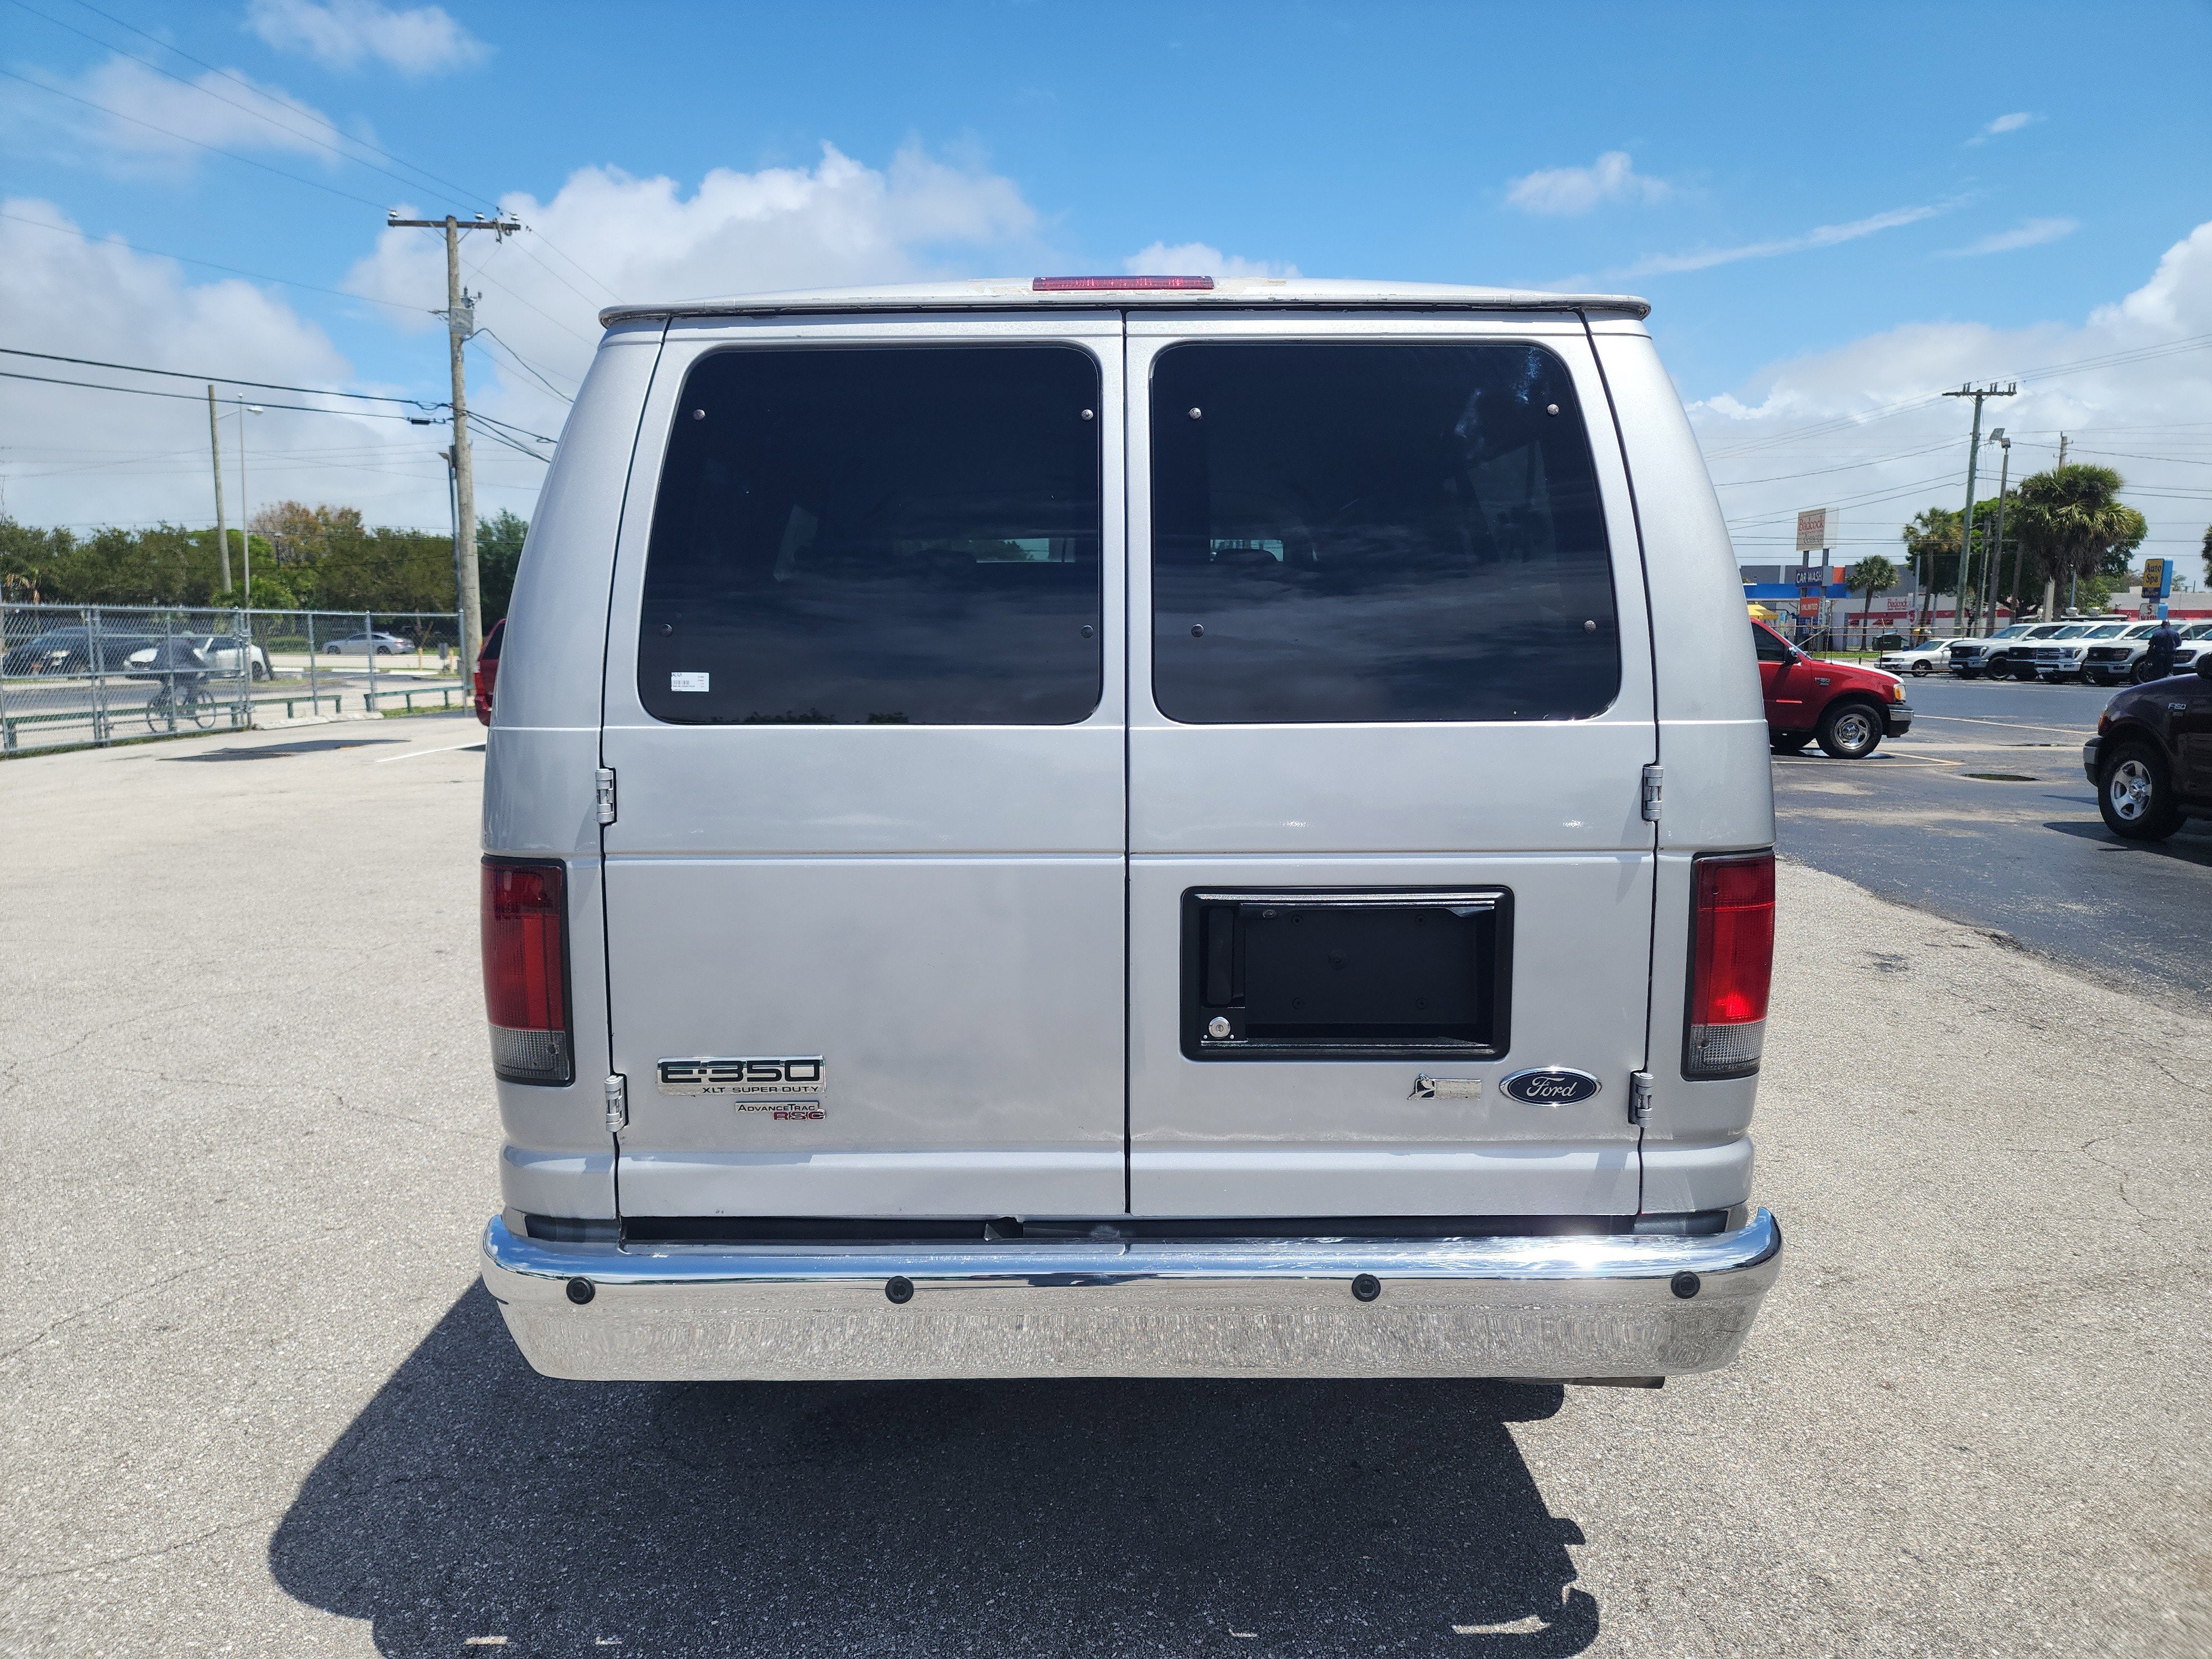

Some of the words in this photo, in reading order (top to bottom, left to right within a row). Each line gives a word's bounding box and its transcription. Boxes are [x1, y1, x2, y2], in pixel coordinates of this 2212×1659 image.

[1798, 515, 1824, 531] Badcock
[2146, 564, 2162, 572] Auto
[1796, 572, 1807, 583] CAR
[1808, 571, 1823, 582] WASH
[2146, 573, 2158, 584] Spa
[1526, 1076, 1578, 1097] Ford
[773, 1112, 825, 1121] RSC
